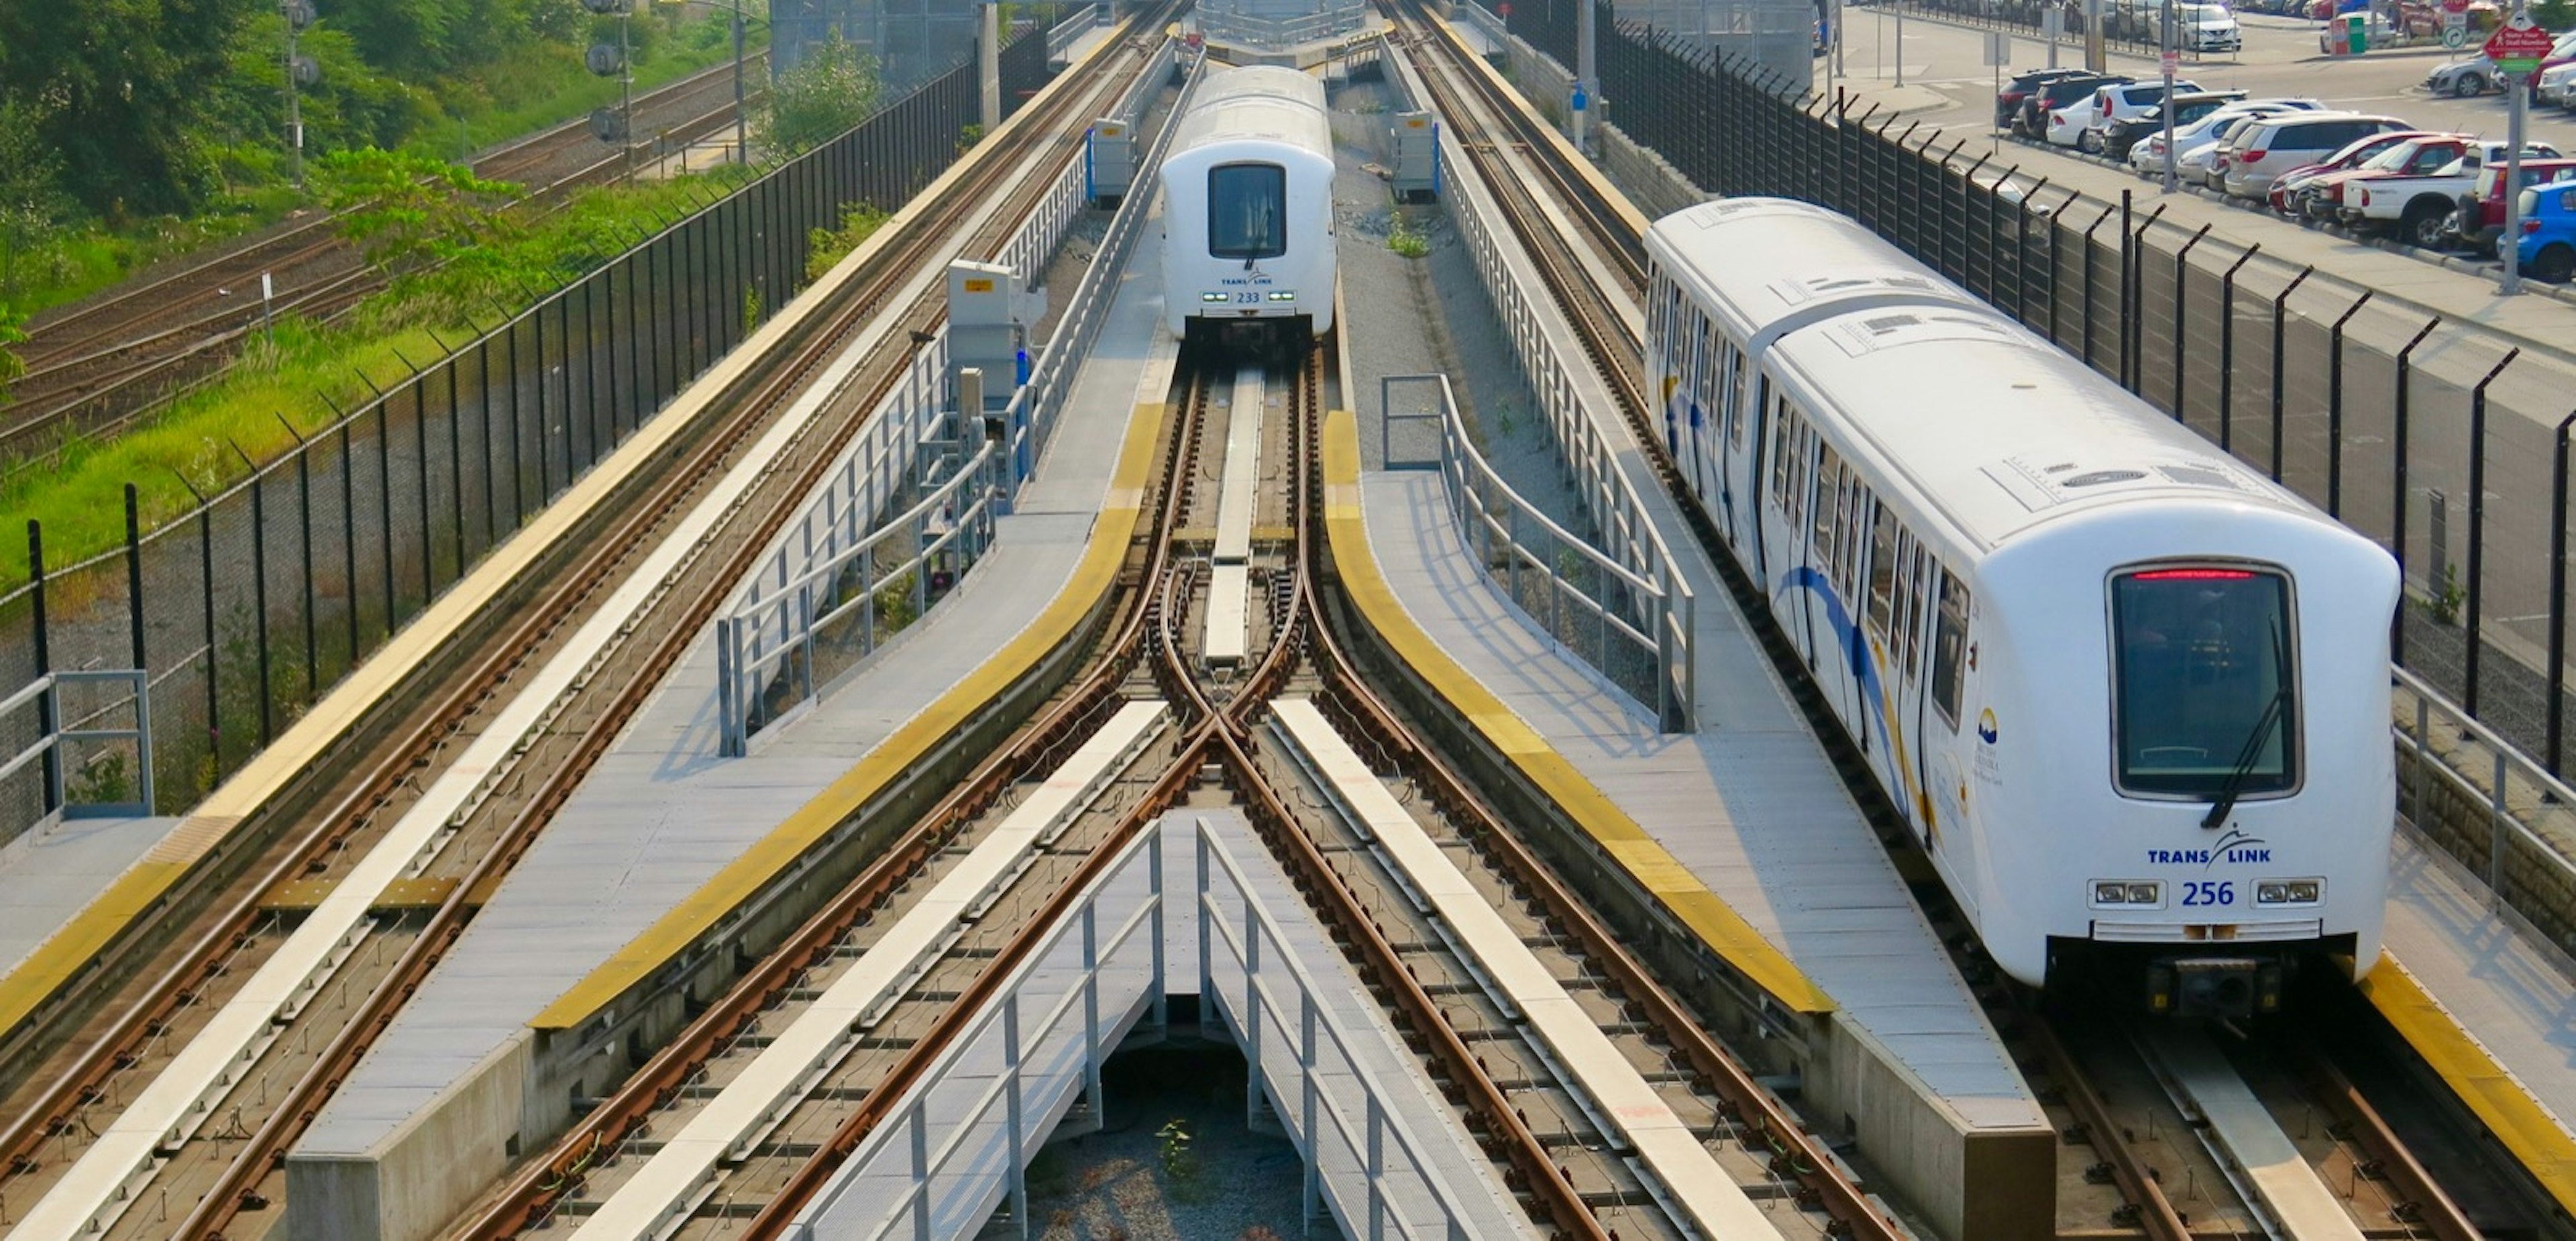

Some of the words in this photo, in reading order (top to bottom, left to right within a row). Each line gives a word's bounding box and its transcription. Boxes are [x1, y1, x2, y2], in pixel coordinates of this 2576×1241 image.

[1238, 292, 1259, 303] 233
[2147, 849, 2209, 863] TRANS
[2228, 849, 2271, 863] LINK
[2182, 881, 2234, 906] 256
